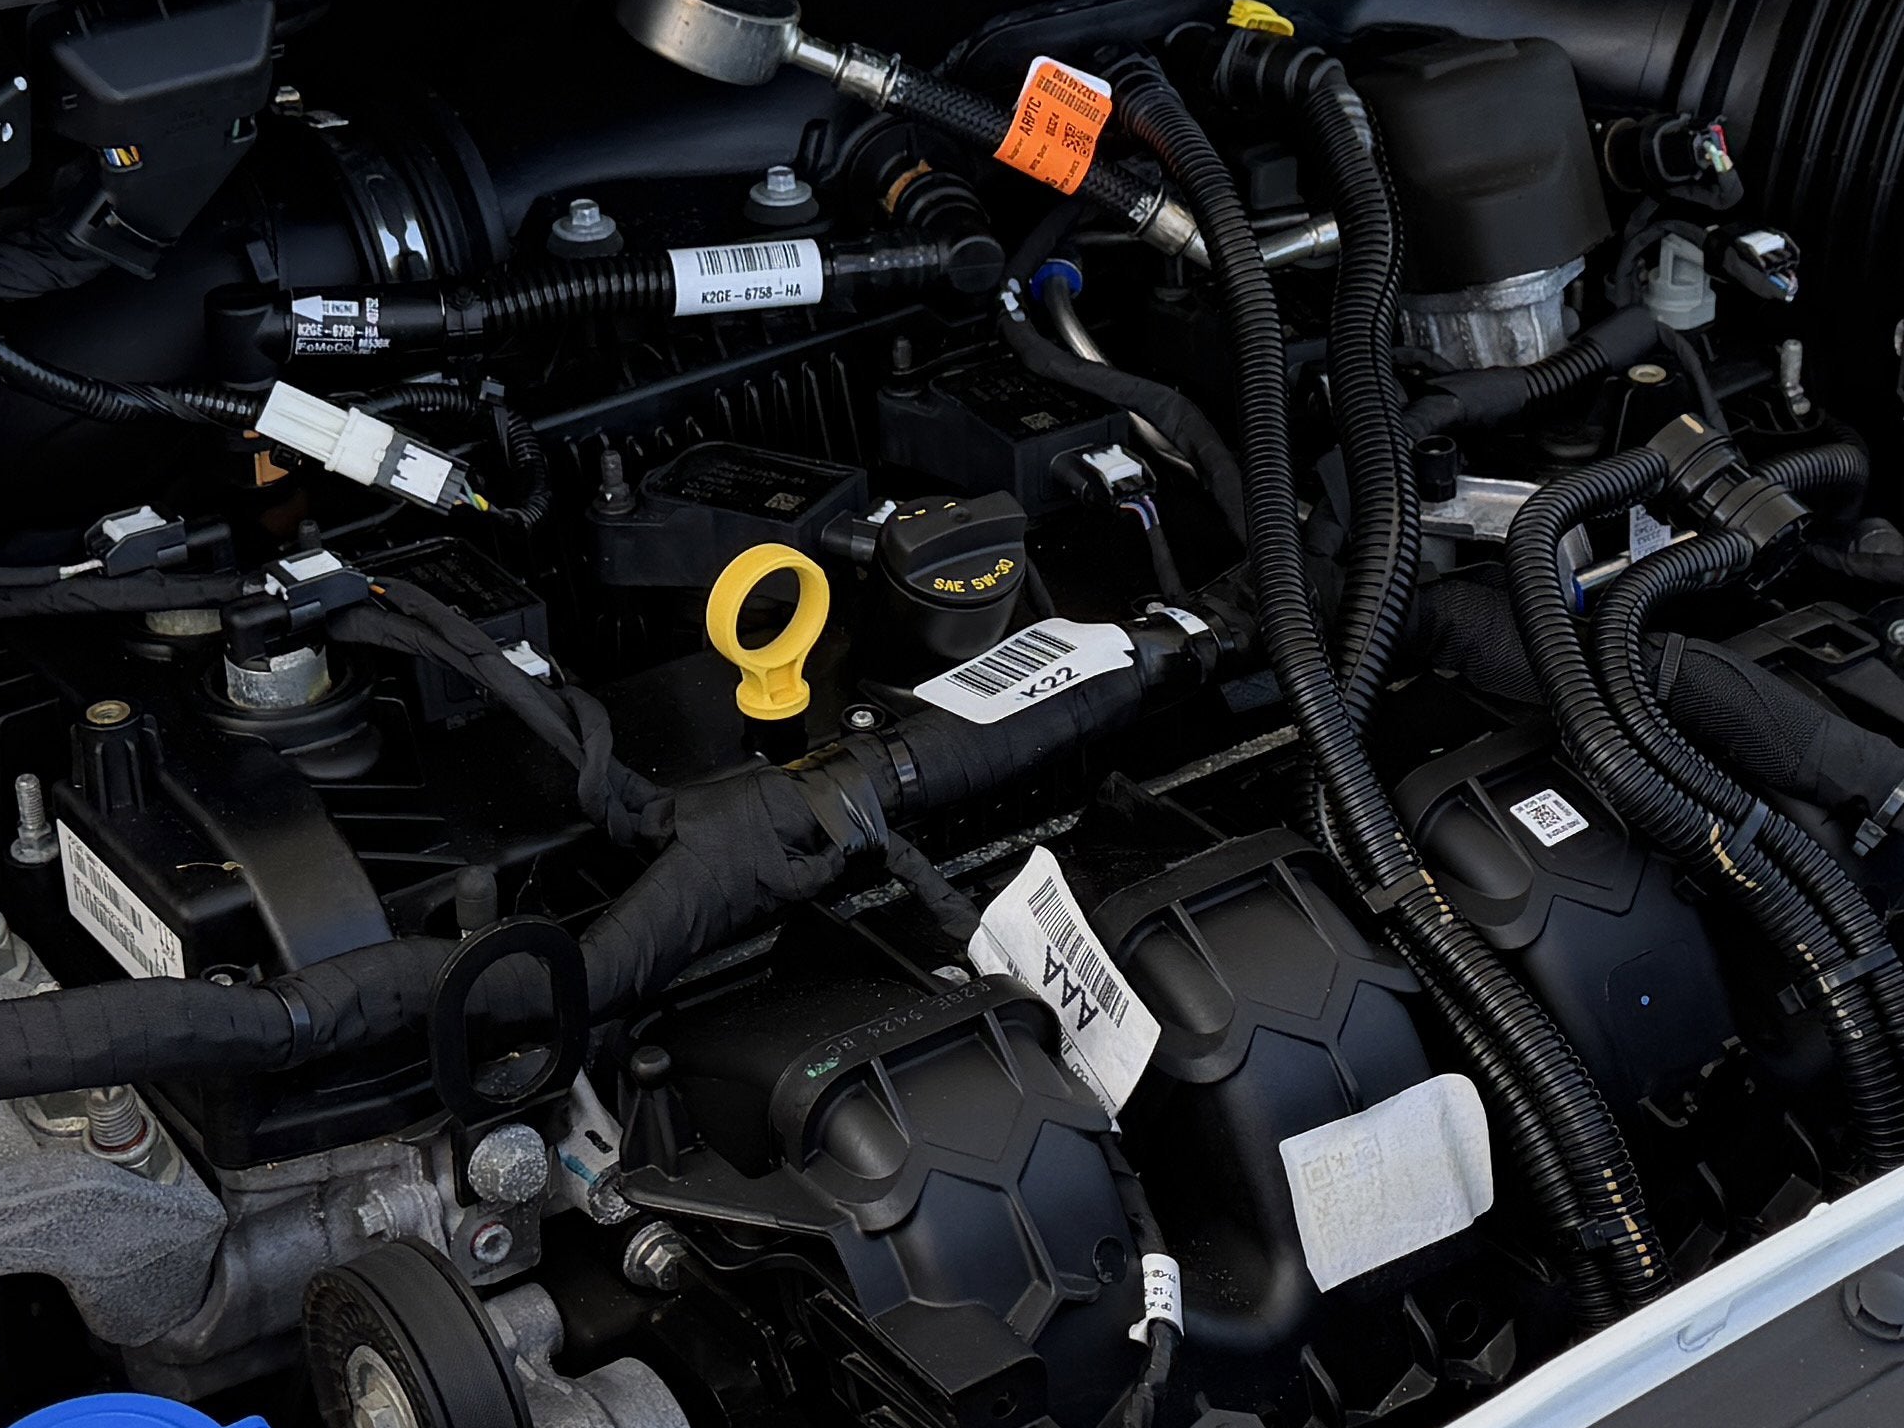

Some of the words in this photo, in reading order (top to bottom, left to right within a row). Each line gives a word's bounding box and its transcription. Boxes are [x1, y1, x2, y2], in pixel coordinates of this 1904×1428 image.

[933, 577, 966, 594] SAE
[971, 558, 1014, 591] 5W-30
[1019, 666, 1082, 699] K22
[1042, 944, 1100, 1032] AAA
